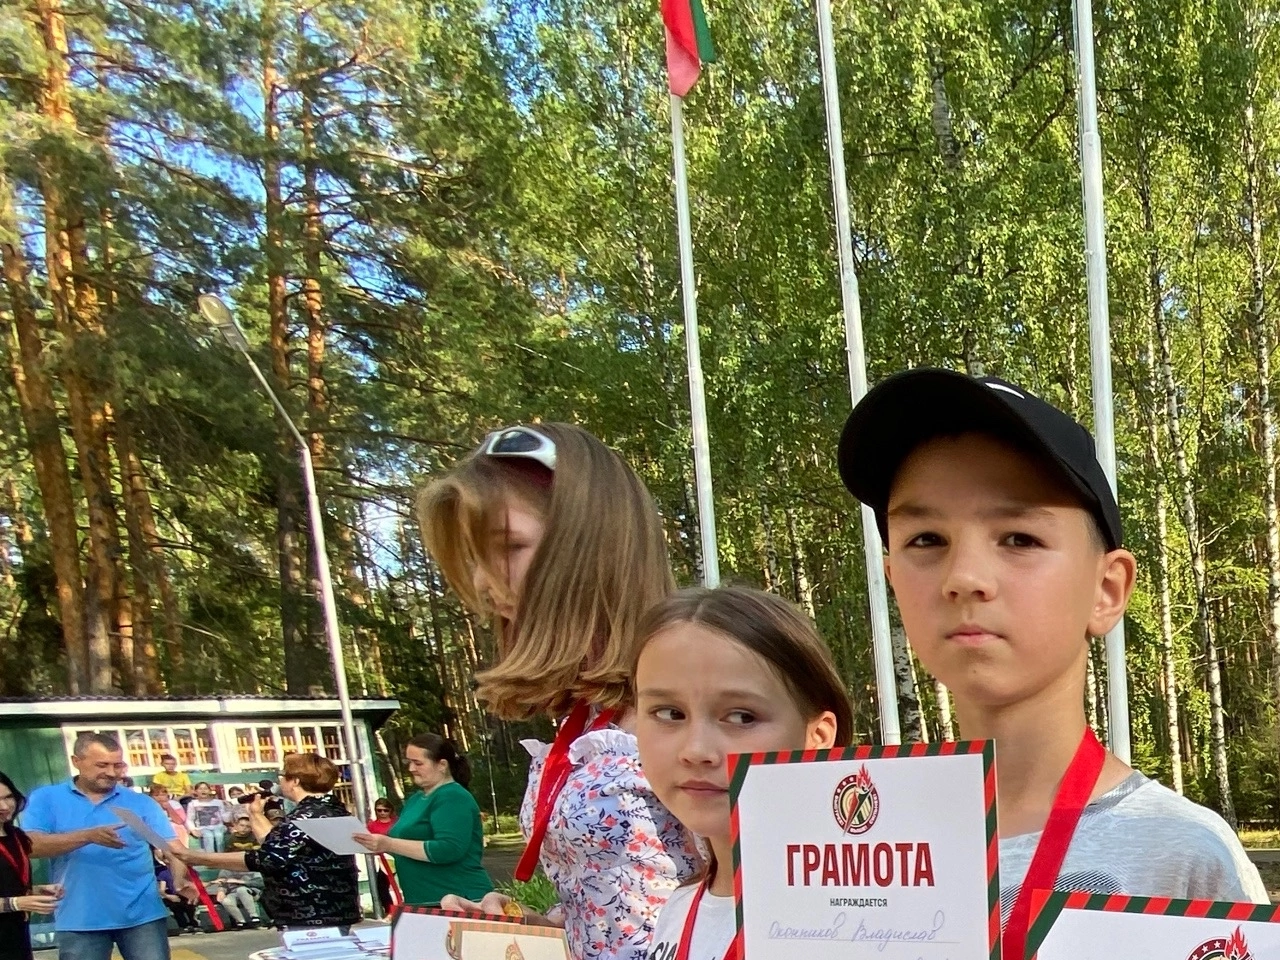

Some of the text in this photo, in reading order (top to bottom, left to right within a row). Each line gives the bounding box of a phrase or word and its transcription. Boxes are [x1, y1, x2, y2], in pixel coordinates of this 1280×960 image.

[786, 842, 935, 887] ГРАМОТА
[830, 898, 887, 908] НАГРАЖДАЕТСЯ
[851, 910, 945, 952] Владислав
